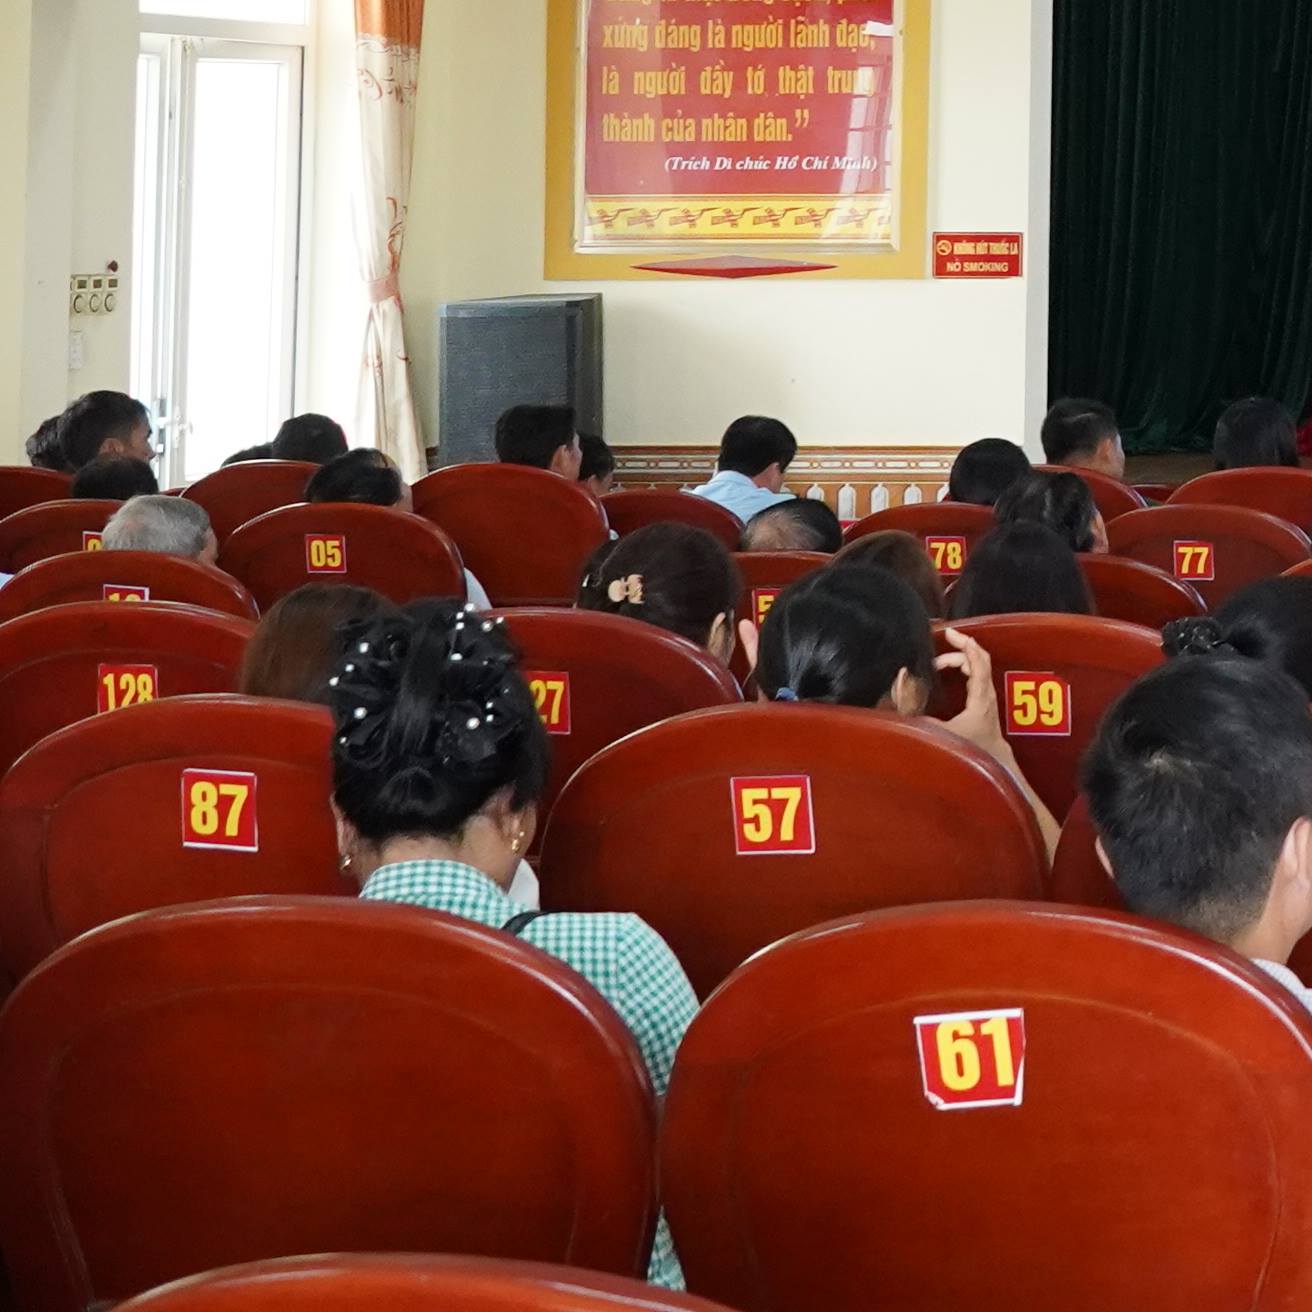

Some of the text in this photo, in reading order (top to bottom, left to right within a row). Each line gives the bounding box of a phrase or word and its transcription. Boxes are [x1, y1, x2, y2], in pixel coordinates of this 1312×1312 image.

[708, 19, 724, 48] là
[603, 66, 619, 94] là
[779, 65, 813, 98] thật
[662, 110, 695, 141] của
[701, 113, 747, 141] nhân
[310, 539, 342, 568] 05
[930, 542, 962, 570] 78
[1178, 546, 1209, 574] 77
[529, 679, 564, 724] 27
[1012, 681, 1064, 726] 59
[190, 782, 248, 837] 87
[742, 788, 802, 843] 57
[936, 1018, 1014, 1090] 61
